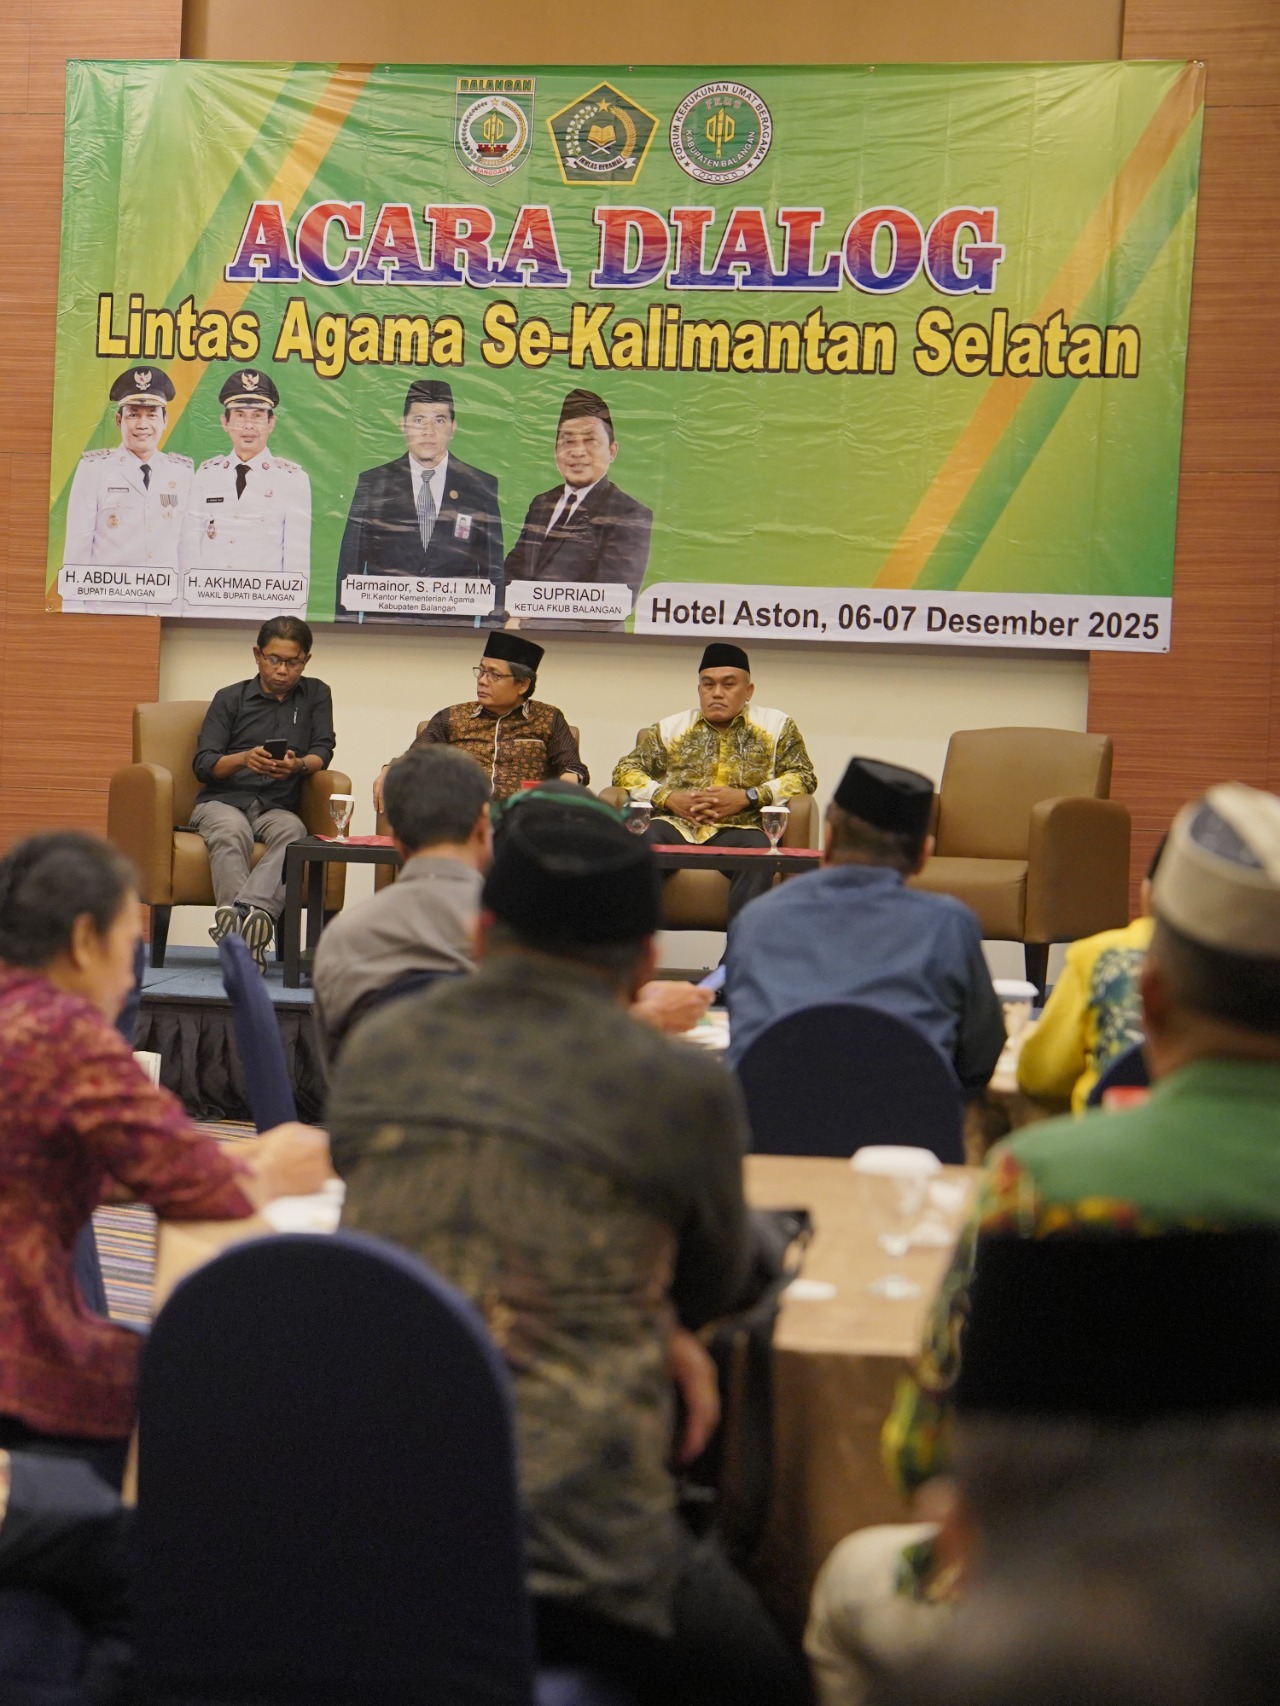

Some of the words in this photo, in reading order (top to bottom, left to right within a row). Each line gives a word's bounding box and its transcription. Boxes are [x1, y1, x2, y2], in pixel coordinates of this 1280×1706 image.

[461, 79, 532, 91] BALANGAN
[732, 85, 758, 104] UMAT
[675, 84, 729, 123] KERUKUNAN
[753, 103, 770, 161] BERAGAMA
[672, 125, 686, 161] FORUM
[686, 129, 719, 167] KABUPATEN
[721, 131, 756, 167] BALANGAN
[223, 200, 571, 289] ACARA
[590, 205, 1005, 295] DIALOG
[95, 293, 261, 361] Lintas
[273, 296, 464, 380] Agama
[481, 299, 898, 375] Se-Kalimantan
[914, 305, 1142, 379] Selatan
[65, 571, 80, 583] H.
[83, 572, 131, 585] ABDUL
[135, 573, 171, 586] HADI
[188, 577, 201, 588] H.
[204, 577, 262, 590] AKHMAD
[265, 579, 303, 591] FAUZI
[77, 587, 107, 596] BUPATI
[108, 588, 156, 597] BALANGAN
[346, 579, 412, 593] Harmainor,
[416, 581, 428, 593] S.
[465, 583, 491, 595] M.M
[533, 587, 605, 602] SUPRIADI
[197, 590, 221, 599] WAKIL
[223, 591, 250, 600] BUPATI
[252, 592, 295, 601] BALANGAN
[399, 593, 446, 603] Kementerian
[448, 595, 475, 605] Agama
[378, 602, 419, 612] Kabupaten
[420, 603, 457, 613] Balangan
[514, 603, 545, 612] KETUA
[547, 604, 571, 612] FKUB
[573, 605, 622, 614] BALANGAN
[651, 598, 725, 625] Hotel
[733, 600, 827, 634] Aston,
[838, 603, 917, 632] 06-07
[927, 606, 1080, 638] Desember
[1088, 611, 1160, 640] 2025
